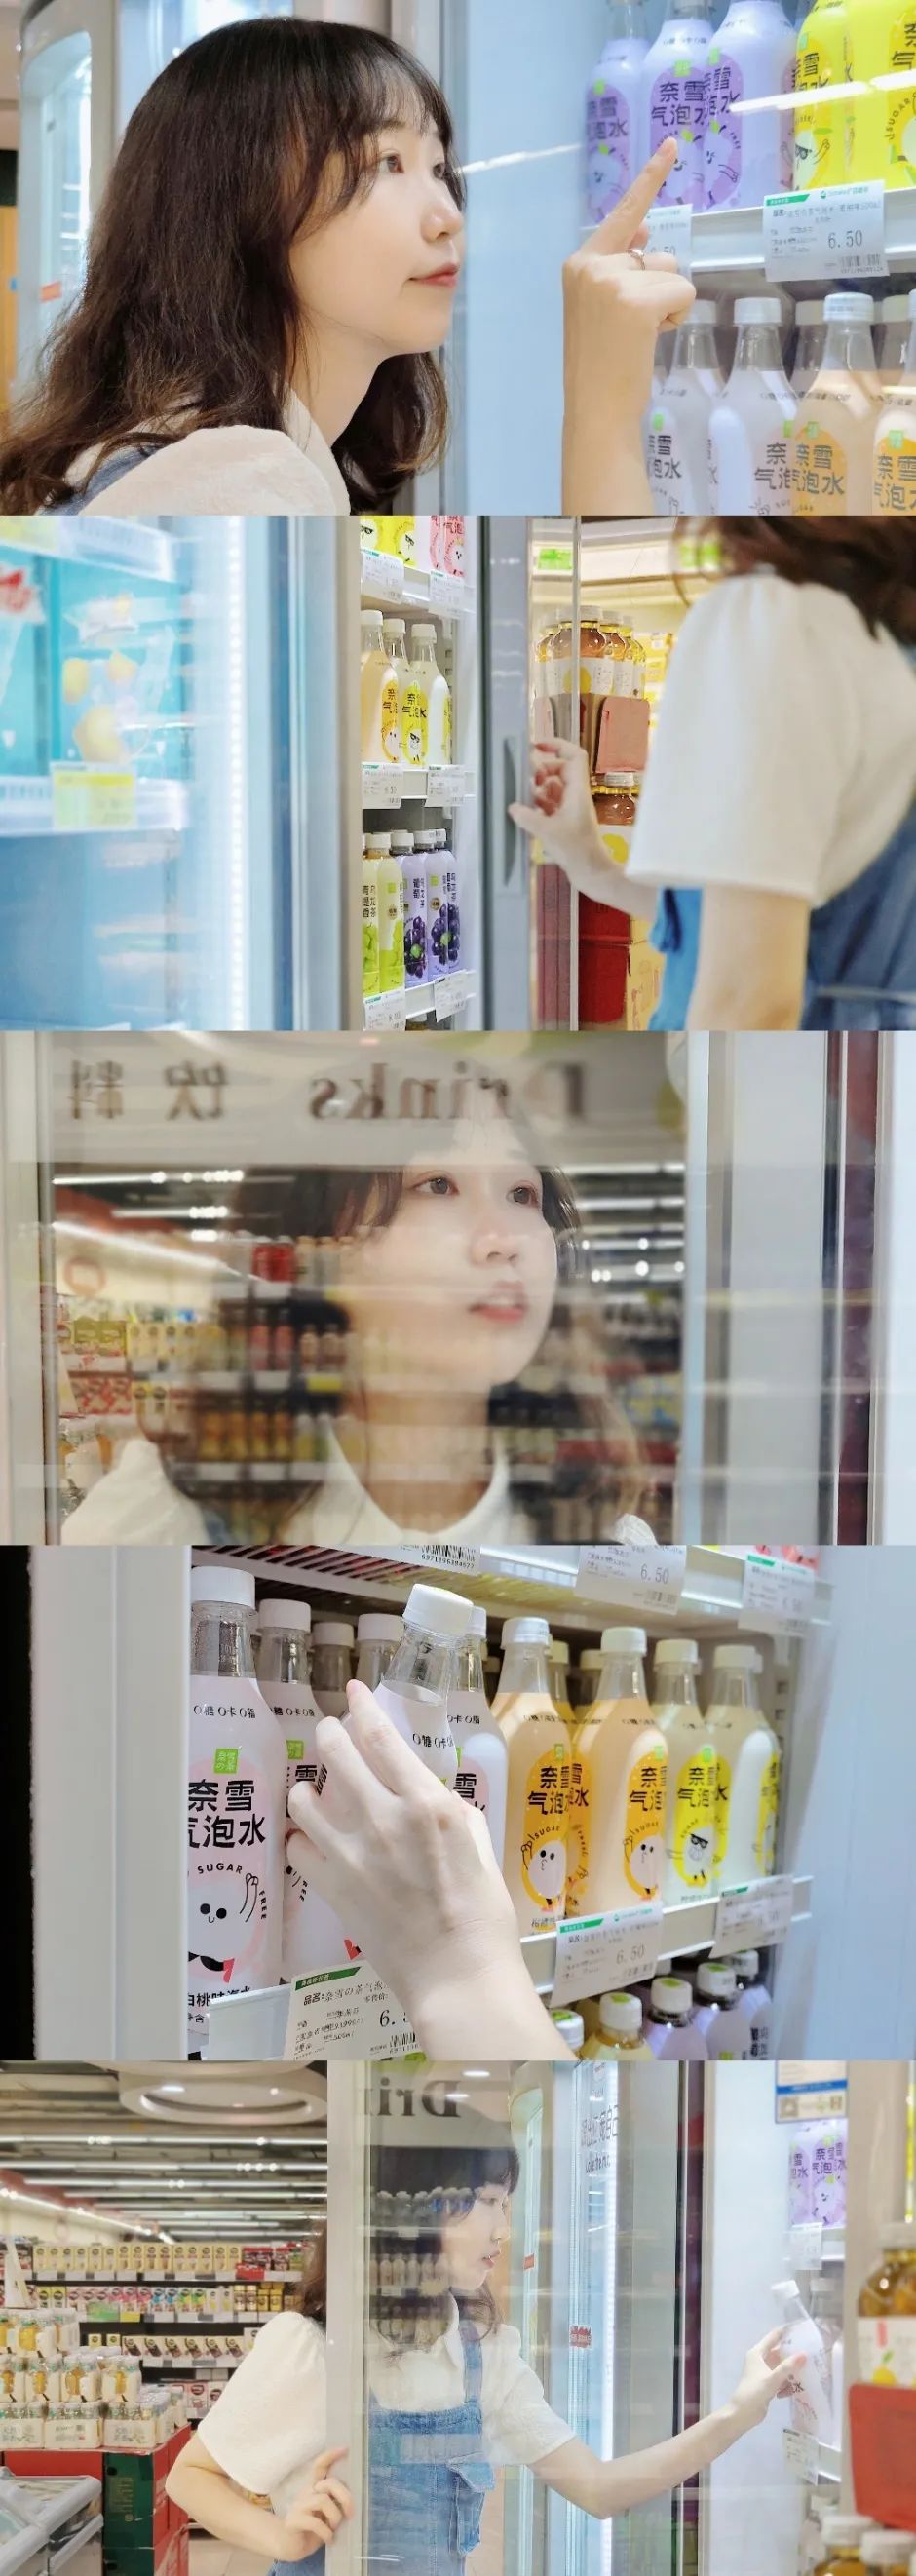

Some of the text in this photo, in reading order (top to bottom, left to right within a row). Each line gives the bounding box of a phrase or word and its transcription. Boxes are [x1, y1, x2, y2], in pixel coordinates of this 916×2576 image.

[827, 229, 863, 249] 6.50
[640, 1563, 669, 1584] 6.50
[188, 1779, 255, 1812] 奈雪
[197, 1863, 243, 1874] SUGAR
[258, 1890, 268, 1920] FREE
